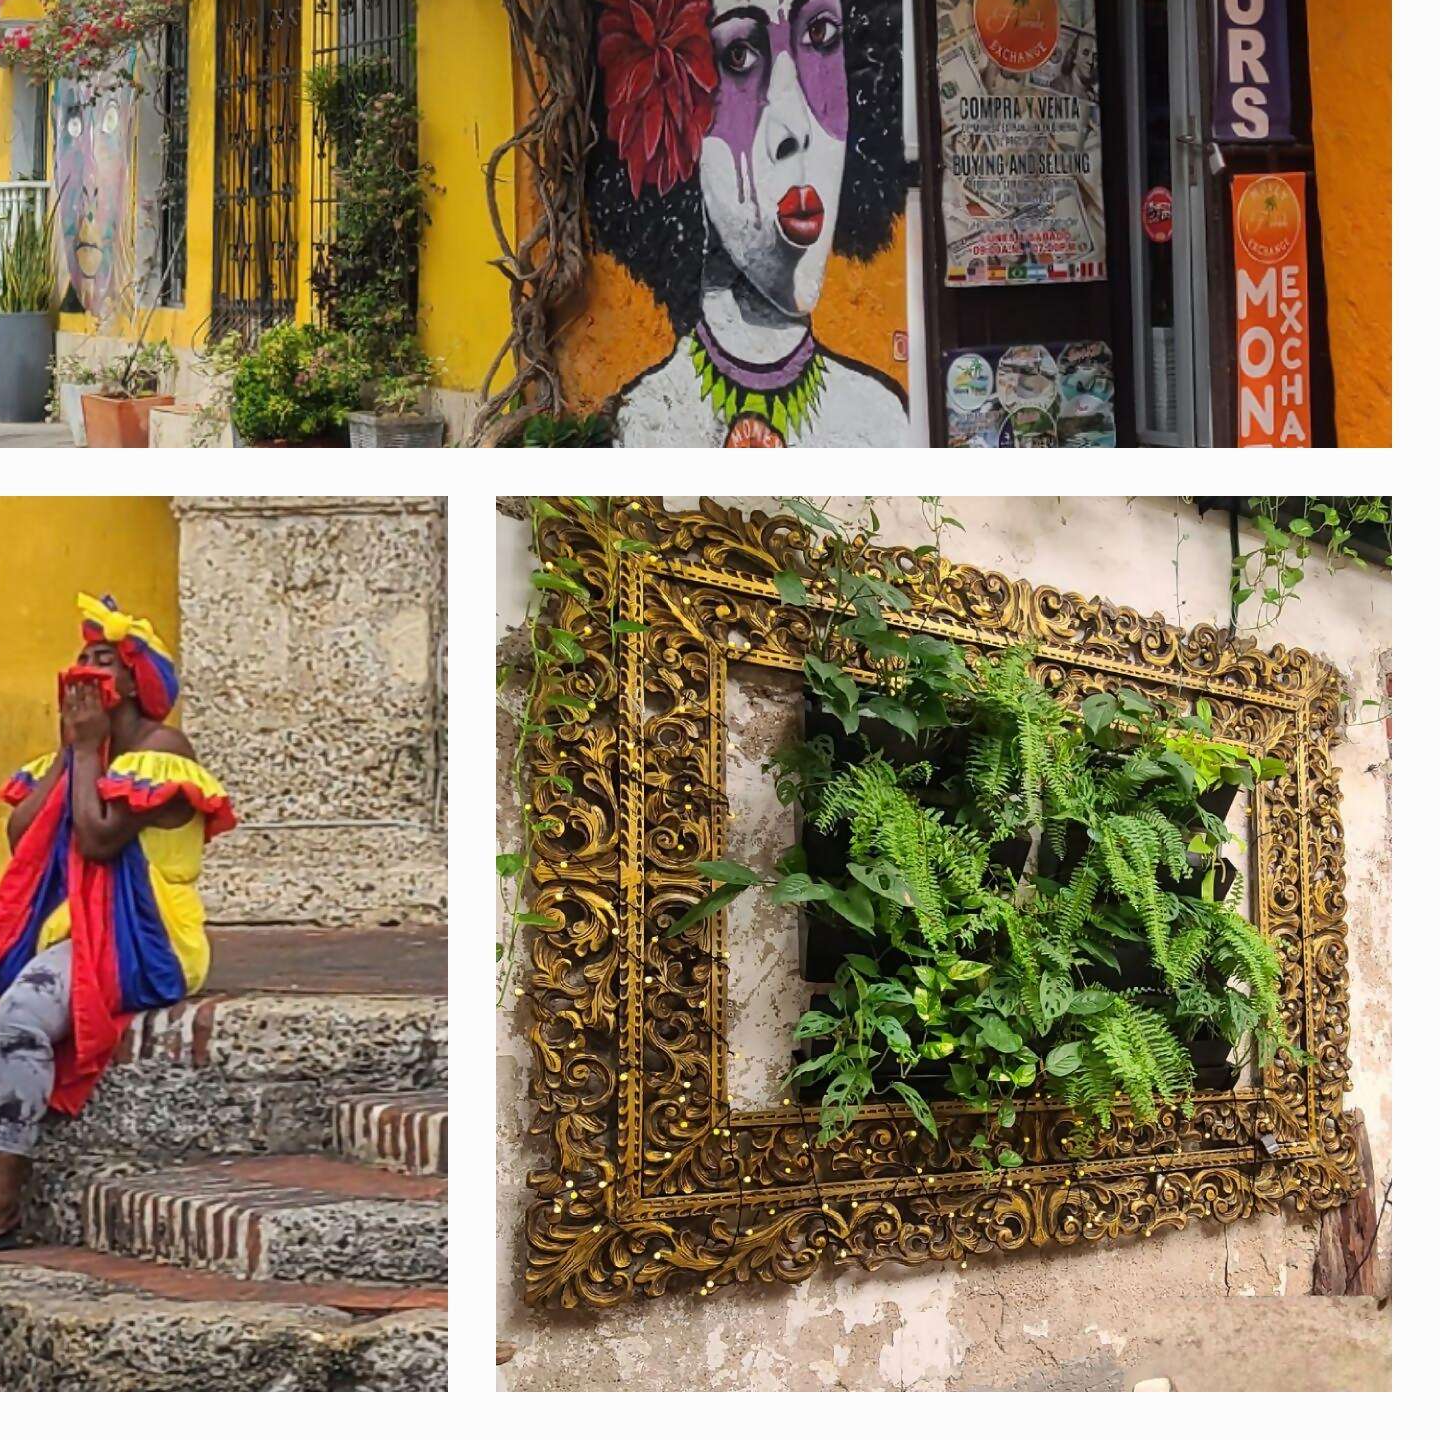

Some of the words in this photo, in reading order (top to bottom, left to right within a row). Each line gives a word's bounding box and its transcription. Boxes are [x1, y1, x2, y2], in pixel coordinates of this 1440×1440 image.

[960, 96, 1021, 120] COMPRA
[1025, 96, 1034, 119] Y
[1037, 96, 1080, 119] VENTA
[952, 154, 1005, 176] BUYING
[1009, 153, 1036, 175] AND
[1039, 152, 1091, 174] SELLING
[1237, 266, 1278, 448] MON
[1280, 265, 1306, 448] EXCHA
